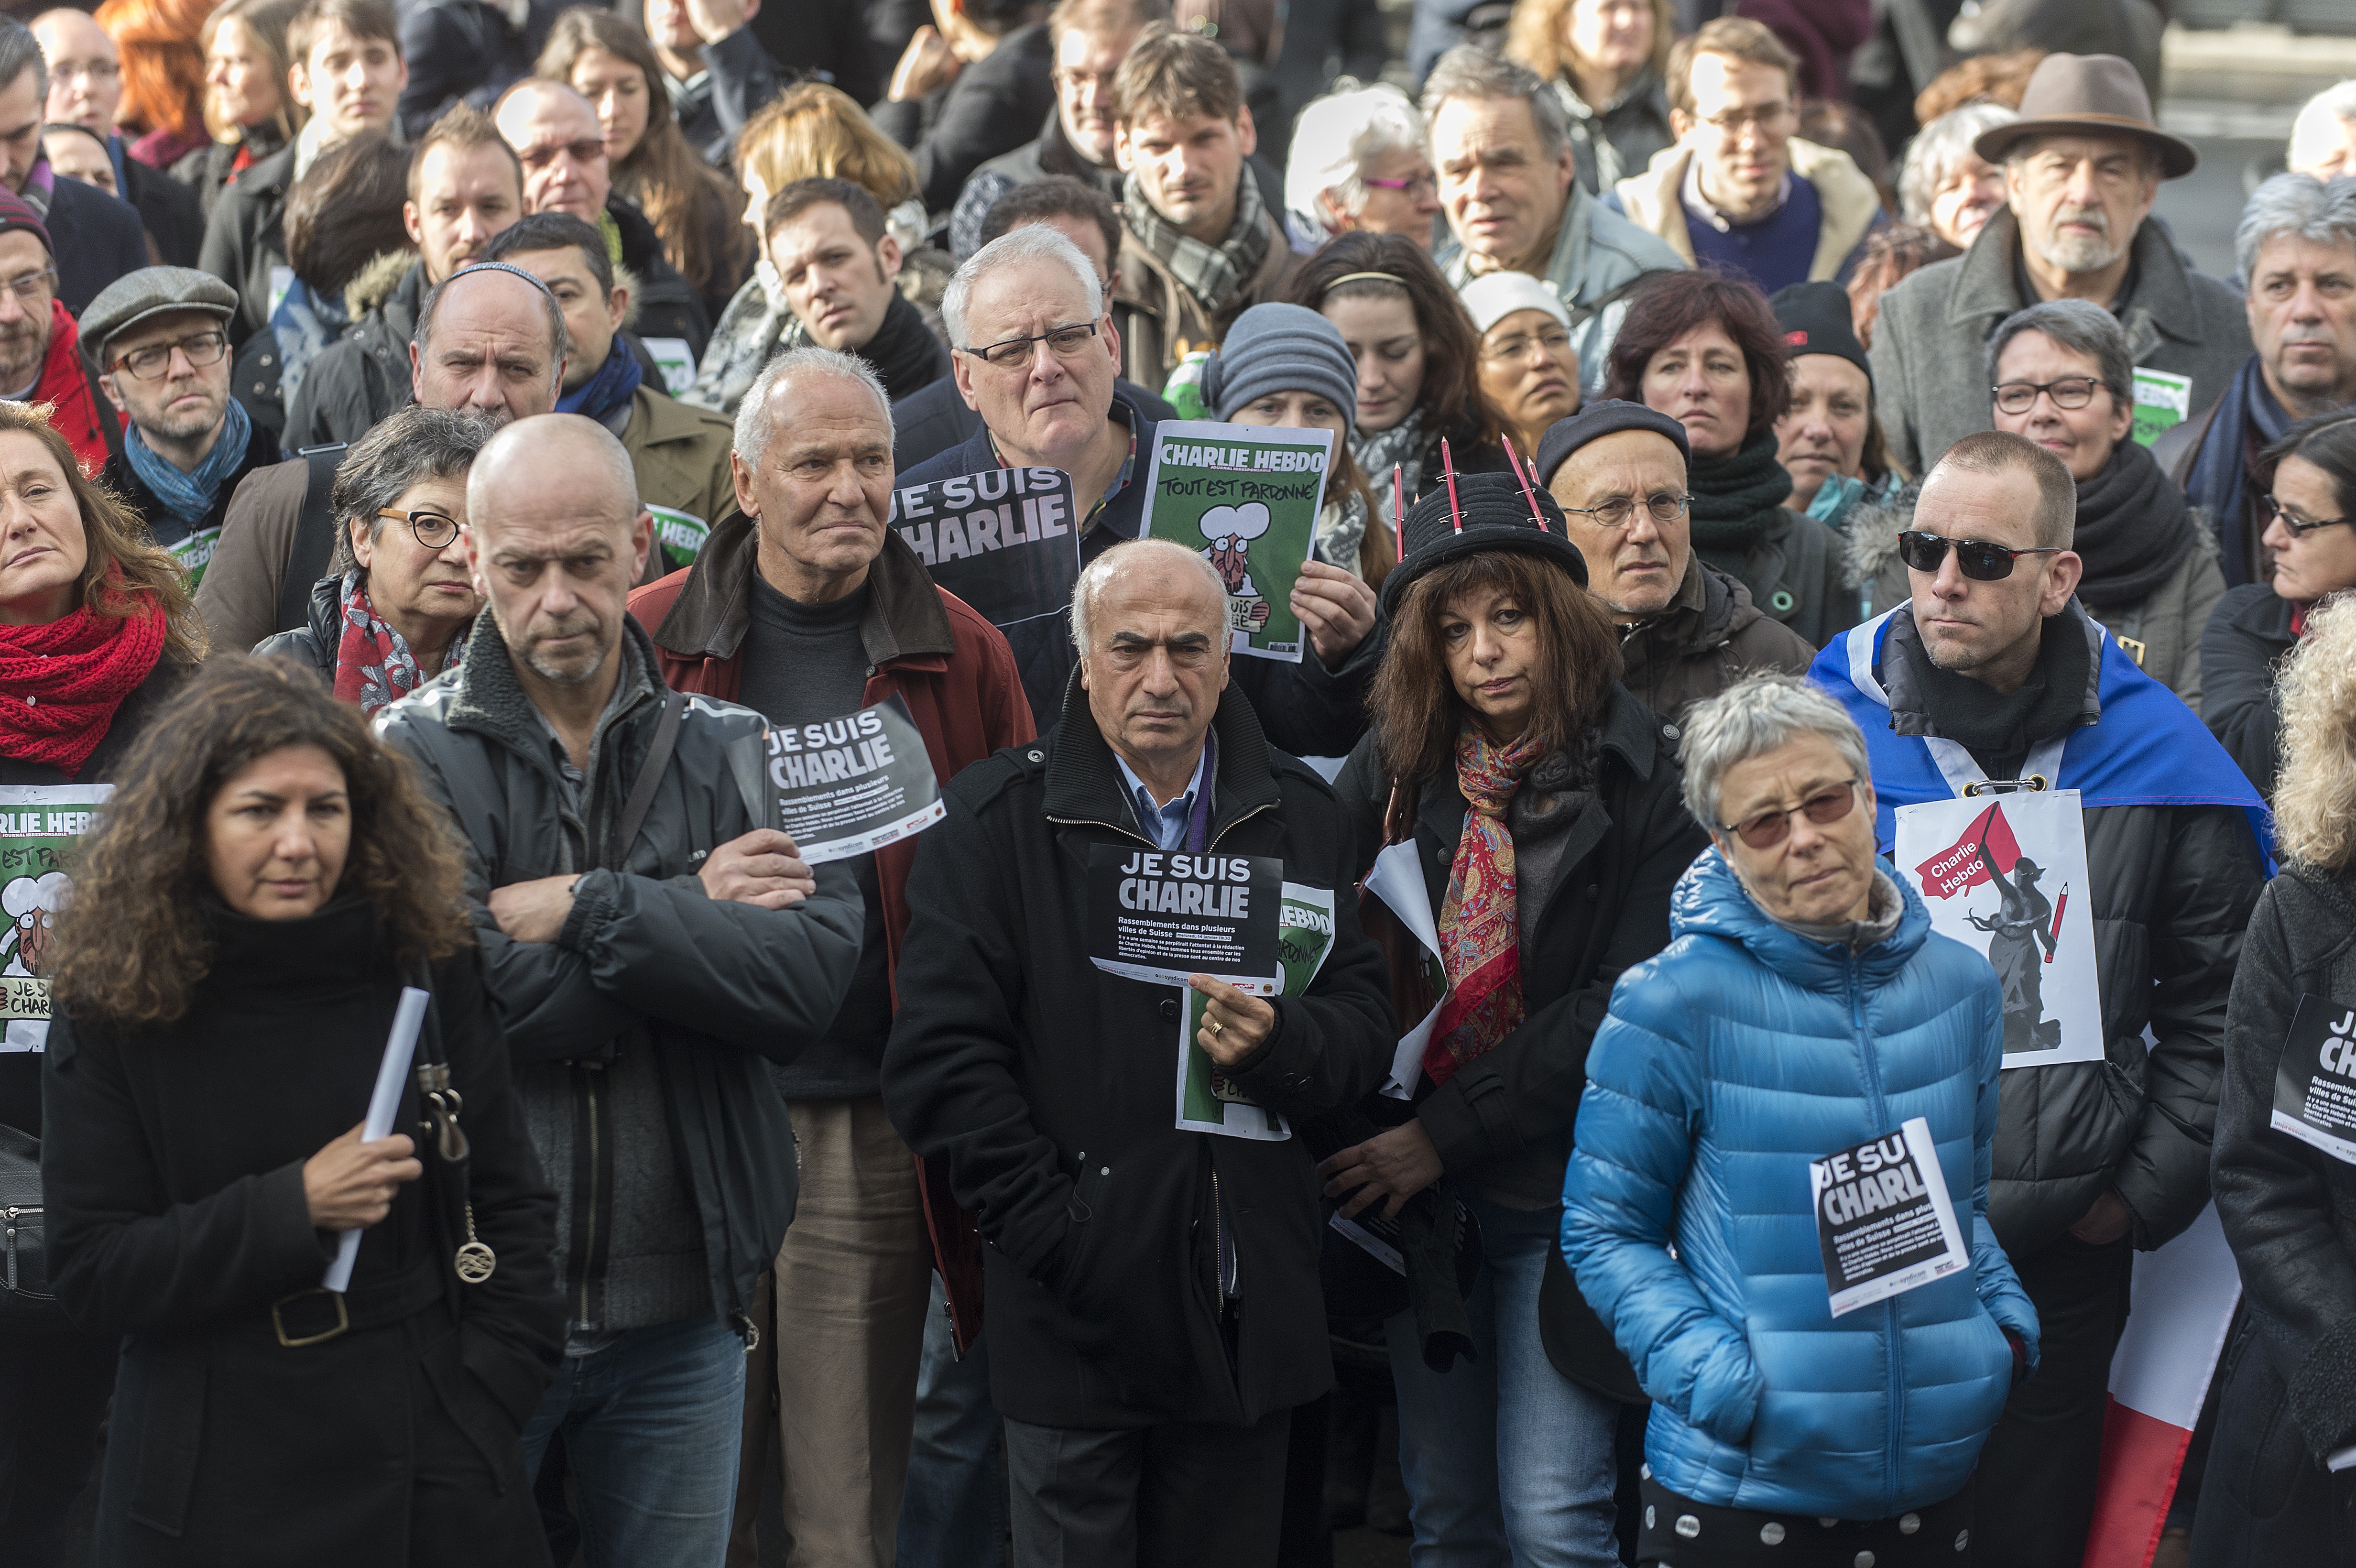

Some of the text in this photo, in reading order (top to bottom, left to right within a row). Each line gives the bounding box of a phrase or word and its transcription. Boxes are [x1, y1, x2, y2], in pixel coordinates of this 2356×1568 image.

[1160, 444, 1326, 472] CHARLIE HEBDO
[942, 467, 1061, 509] SUIS
[1159, 477, 1319, 501] TOUT EST PARDONNÉ
[894, 494, 1068, 566] HARLIE
[768, 711, 883, 756] JE SUIS
[769, 733, 895, 790] CHARLIE
[779, 775, 889, 806] Rassemblements dans plusieurs
[807, 802, 832, 812] Suisse
[839, 841, 864, 850] syndicom
[2, 846, 35, 869] EST
[1120, 852, 1251, 882] JE SUIS
[1931, 843, 1976, 877] Charlie
[1940, 860, 1984, 894] Hebdo
[1119, 878, 1250, 918] CHARLIE
[1118, 916, 1179, 929] Rassemblements
[1201, 925, 1235, 933] plusieurs
[1118, 926, 1137, 934] villes
[1149, 929, 1173, 937] Suisse
[1096, 965, 1126, 975] mpressum
[1165, 975, 1189, 983] syndicom
[14, 981, 35, 997] JE
[2329, 1010, 2356, 1039] J
[2310, 1086, 2356, 1107] villes de Sui
[2304, 1107, 2322, 1118] libertés
[2322, 1114, 2345, 1125] d'opinion
[2312, 1103, 2330, 1114] Charlie
[2330, 1109, 2347, 1119] Hebdo.
[2330, 1102, 2351, 1114] semaine
[2274, 1120, 2307, 1139] impressum
[2303, 1113, 2333, 1129] démocraties.
[1822, 1133, 1911, 1188] JE SU
[1824, 1163, 1928, 1226] CHARL
[1895, 1209, 1915, 1222] dans
[1332, 1220, 1359, 1242] impressum
